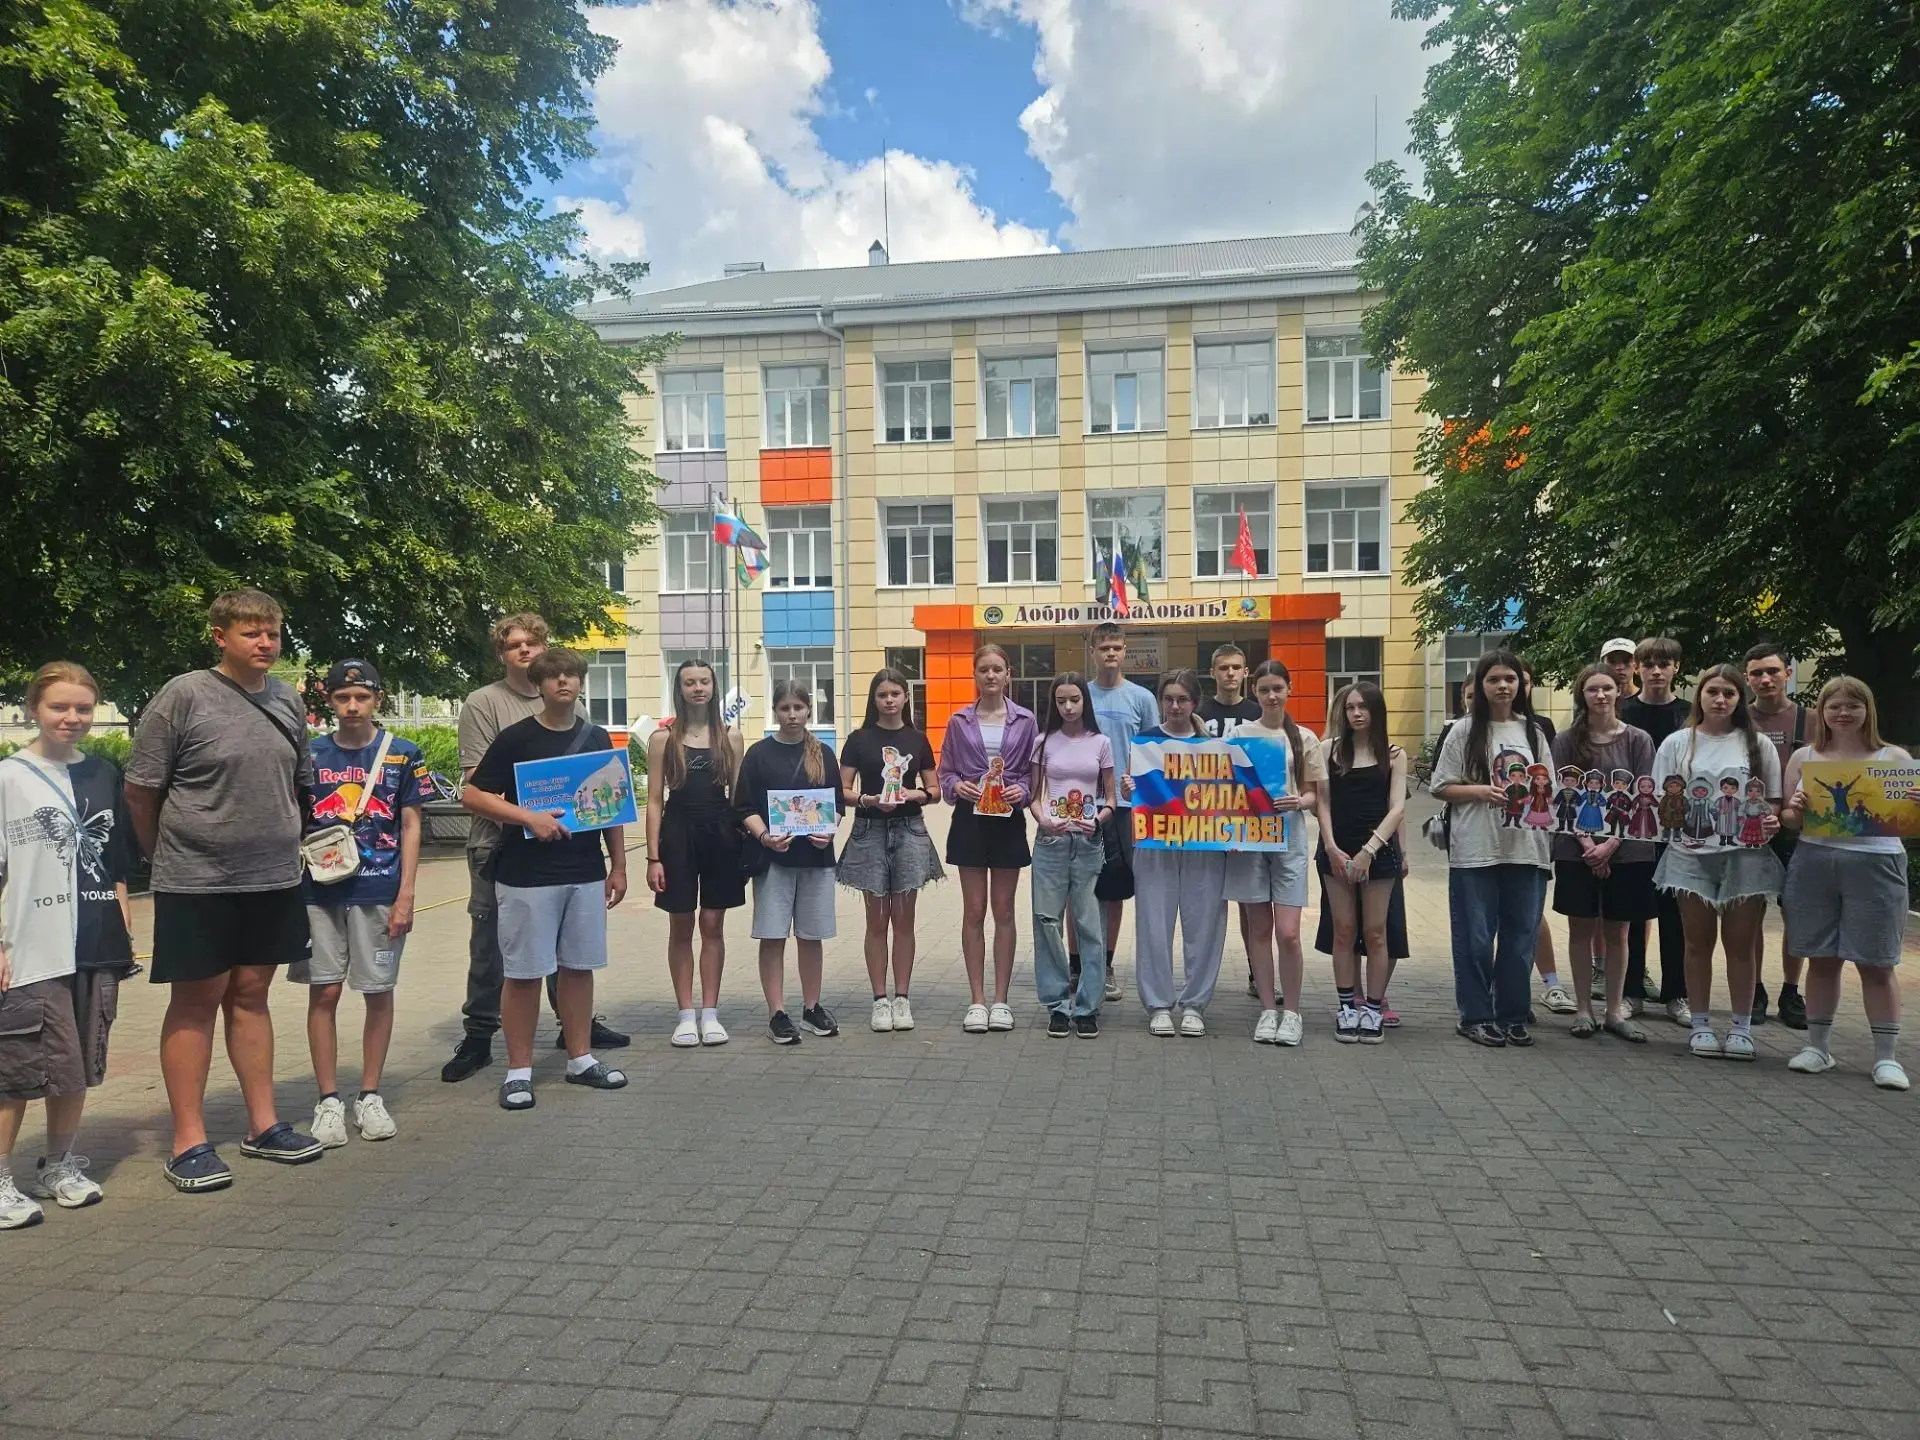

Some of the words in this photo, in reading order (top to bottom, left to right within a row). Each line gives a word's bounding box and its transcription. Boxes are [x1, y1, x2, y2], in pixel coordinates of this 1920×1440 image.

[1014, 605, 1080, 623] Добро
[319, 765, 352, 784] Red
[353, 765, 384, 784] Bl
[1164, 753, 1233, 780] НАША
[523, 793, 574, 809] ЮНОСТЬ
[1184, 783, 1249, 811] СИЛА
[1885, 791, 1908, 800] 202
[1134, 812, 1148, 840] В
[1152, 814, 1284, 847] ЕДИНСТВЕ!
[34, 897, 53, 908] TO
